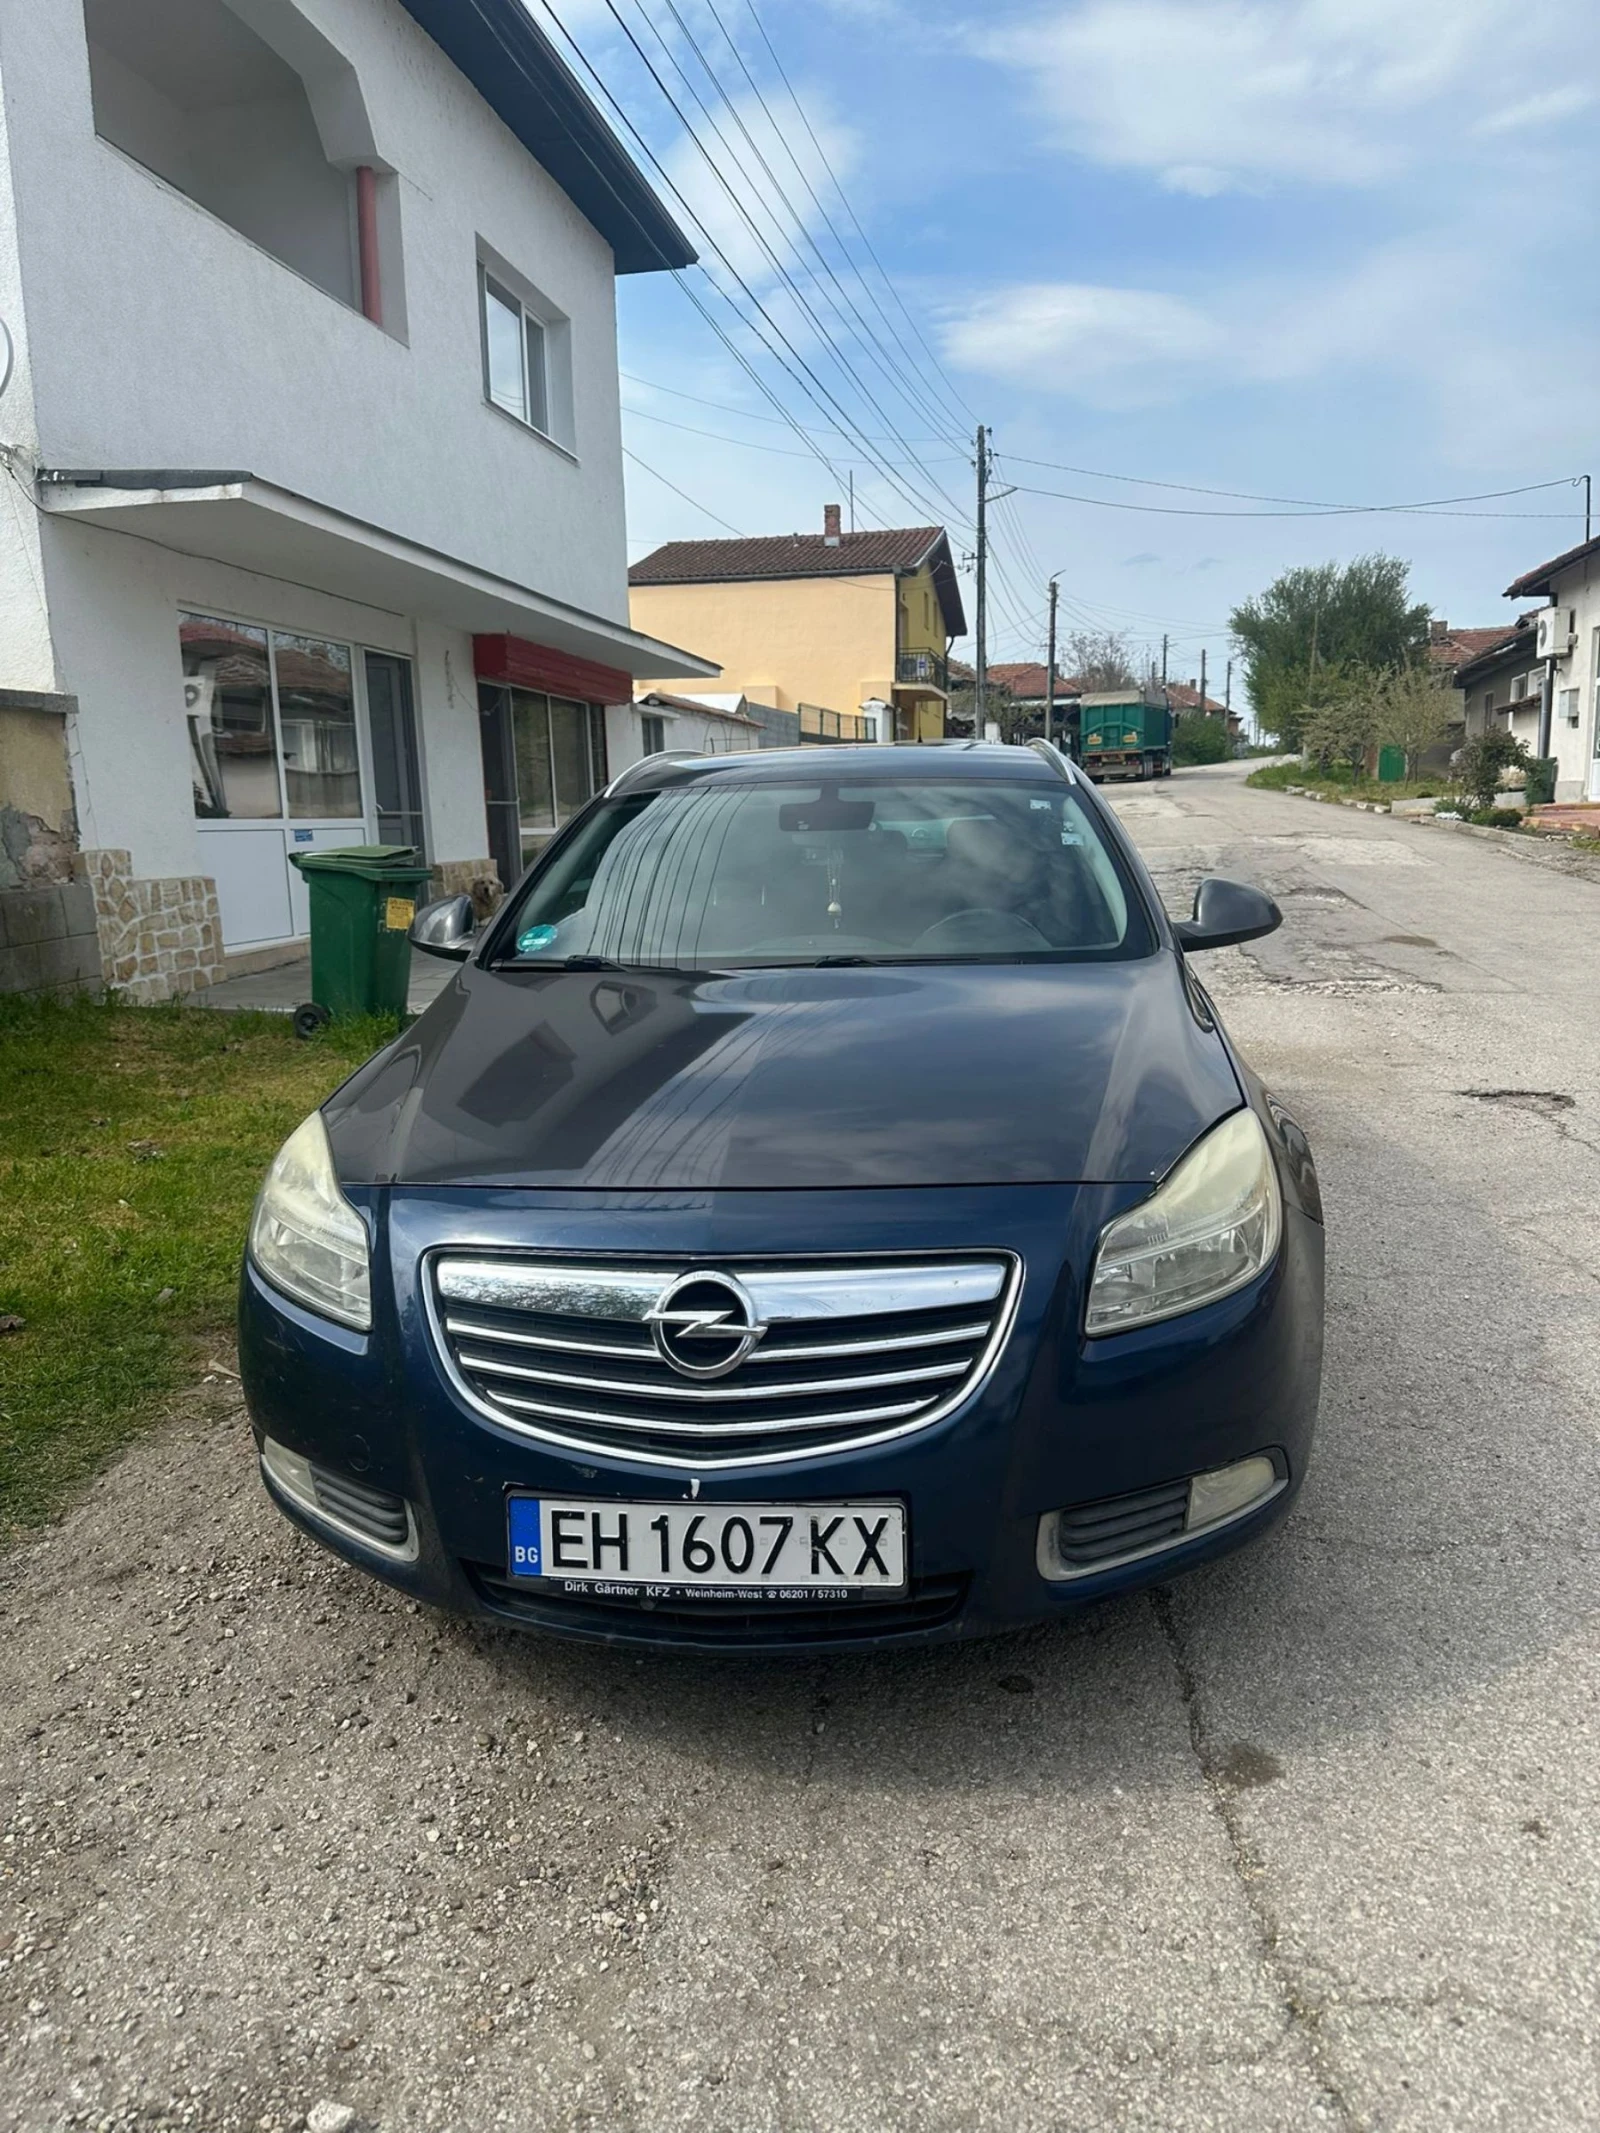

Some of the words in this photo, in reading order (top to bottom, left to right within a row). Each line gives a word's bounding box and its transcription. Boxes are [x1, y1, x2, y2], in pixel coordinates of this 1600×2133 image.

[551, 1509, 629, 1571] EH
[650, 1514, 793, 1575] 1607
[810, 1516, 890, 1576] KX
[514, 1546, 539, 1565] BG
[564, 1580, 589, 1593] Dirk
[594, 1582, 639, 1596] Gärtner
[646, 1586, 671, 1598] KFZ
[685, 1588, 763, 1599] Weinheim-West
[779, 1589, 809, 1599] 06201
[817, 1589, 848, 1599] 57310
